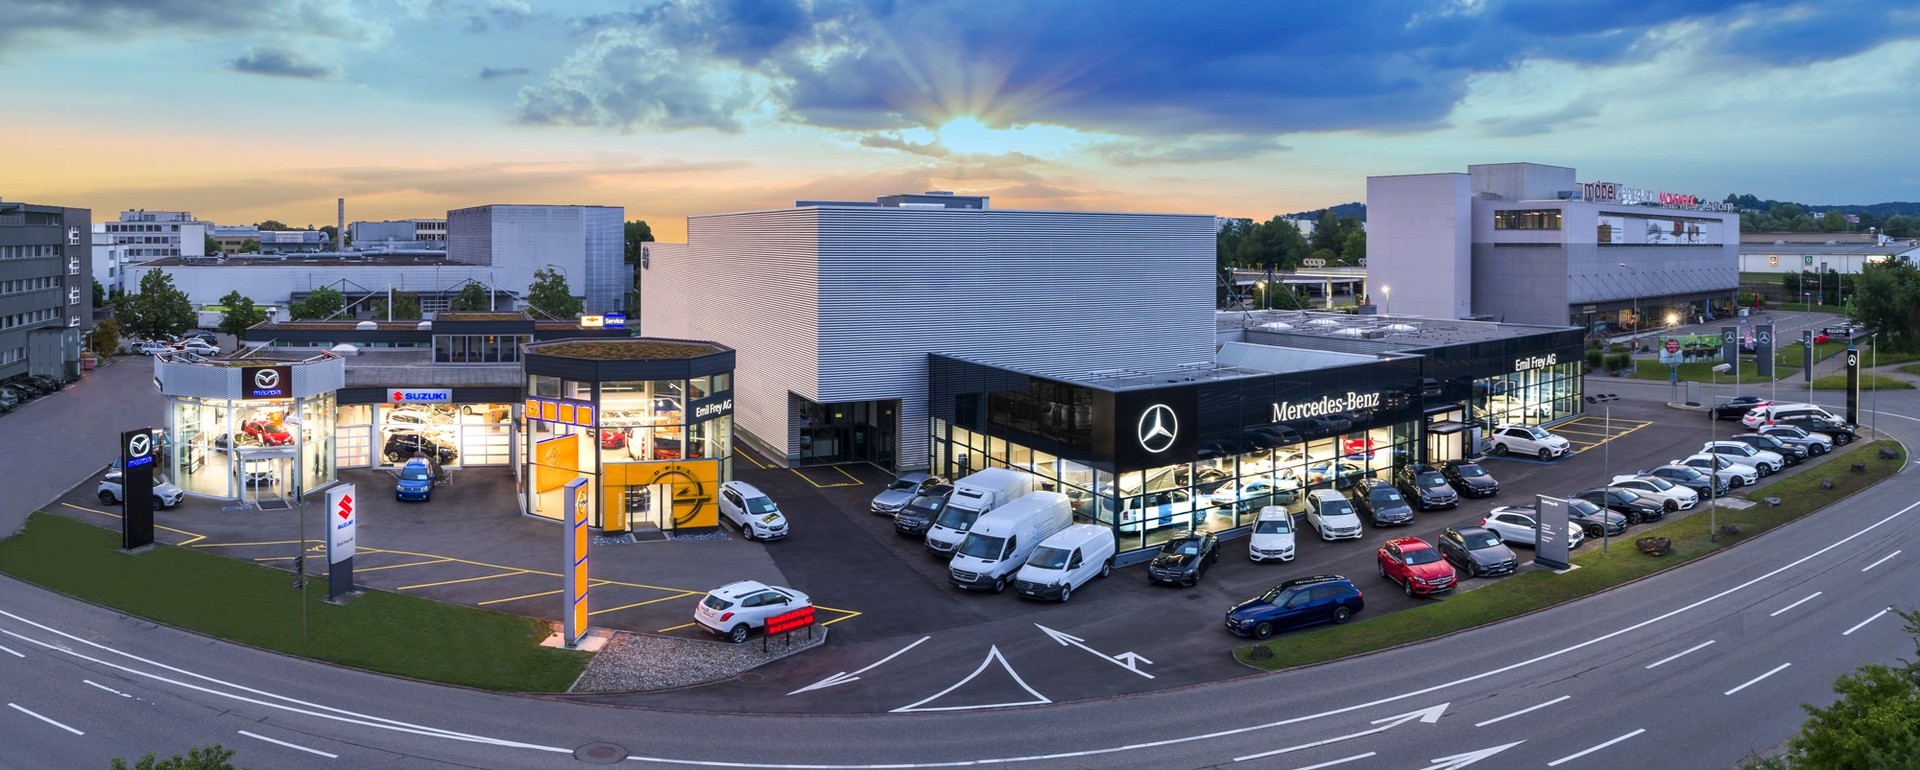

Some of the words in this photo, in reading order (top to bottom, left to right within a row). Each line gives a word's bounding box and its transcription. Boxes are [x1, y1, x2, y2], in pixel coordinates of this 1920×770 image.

[1515, 357, 1530, 371] Emil
[1531, 356, 1545, 370] Frey
[1546, 353, 1556, 365] AG
[405, 392, 447, 400] SUZUKI
[696, 404, 709, 418] Emil
[710, 403, 722, 414] Frey
[722, 399, 732, 410] AG
[1272, 391, 1380, 423] Mercedes-Benz
[653, 465, 692, 477] OPEL
